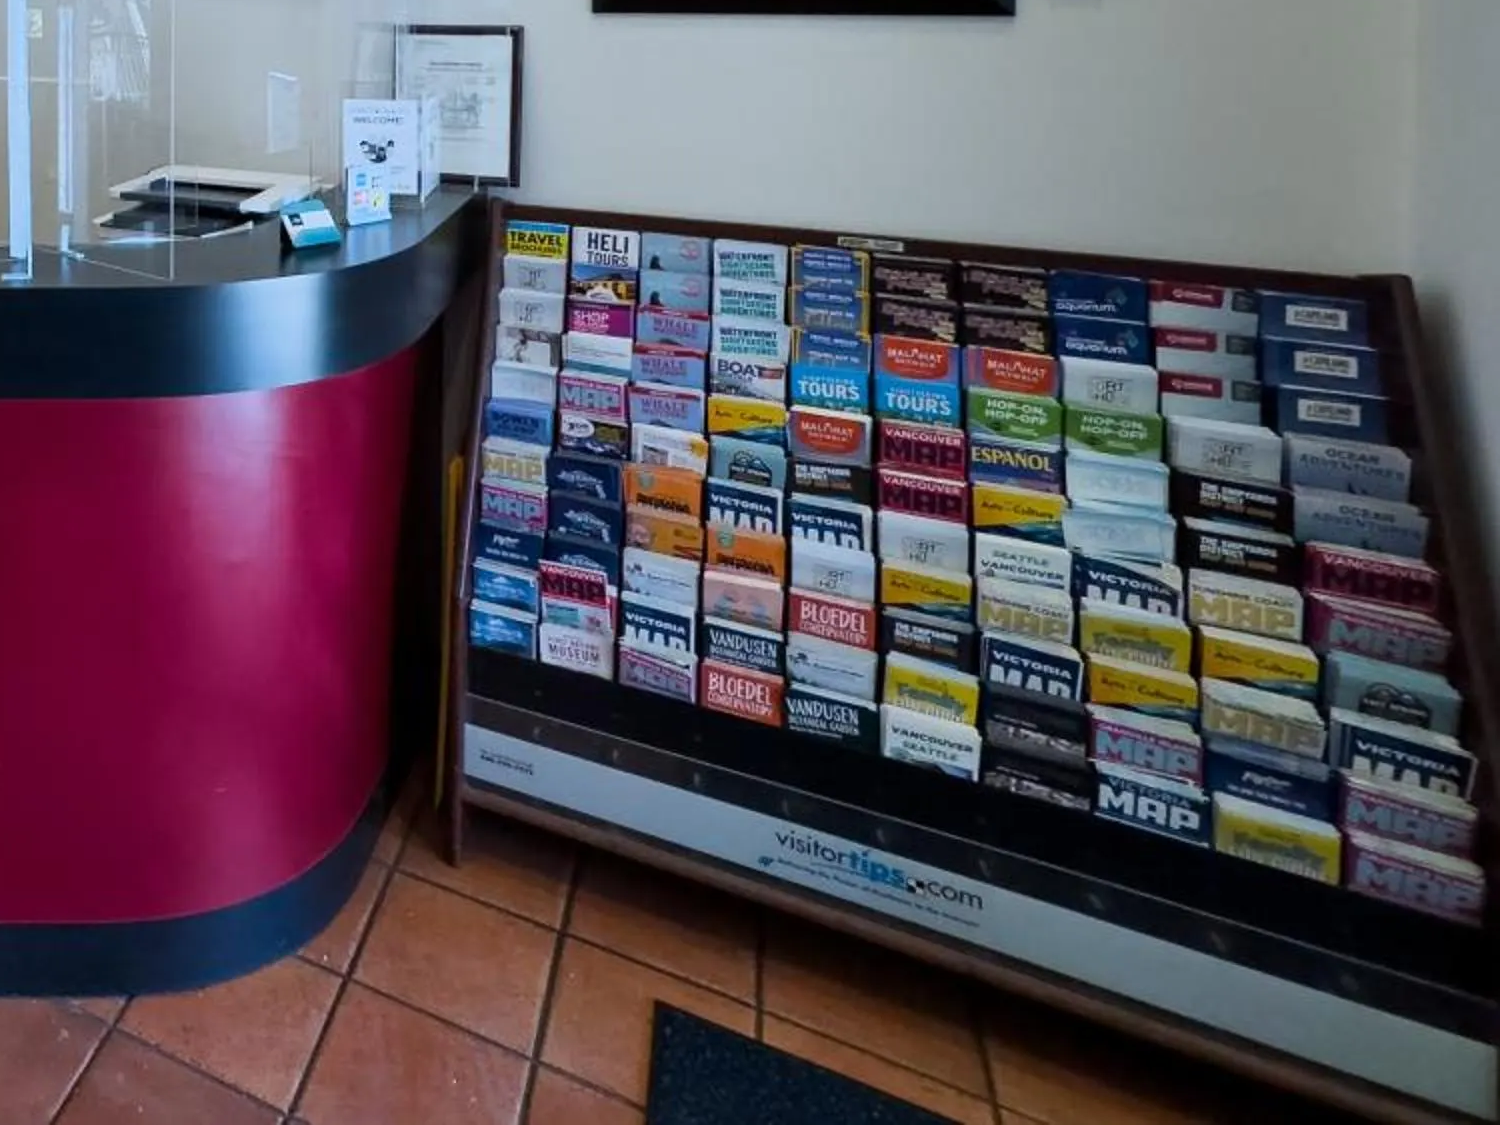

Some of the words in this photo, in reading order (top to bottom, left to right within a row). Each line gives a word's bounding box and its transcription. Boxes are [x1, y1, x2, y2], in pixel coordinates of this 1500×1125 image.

[510, 231, 563, 247] TRAVEL
[587, 232, 629, 253] HELI
[586, 251, 629, 267] TOURS
[717, 359, 760, 378] BOAT
[562, 384, 619, 409] MAP
[798, 380, 860, 400] TOURS
[887, 392, 950, 415] TOURS
[985, 408, 1048, 424] HOP-OFF
[885, 428, 961, 447] VANCOUVER
[1080, 426, 1147, 440] HOP-OFF
[484, 456, 542, 479] MAP
[1325, 449, 1380, 465] OCEAN
[883, 477, 961, 495] VANCOUVER
[484, 495, 537, 519] MAP
[711, 494, 772, 513] VICTORIA
[1013, 505, 1054, 519] Culture
[792, 513, 857, 531] VICTORIA
[981, 559, 1064, 580] VANCOUVER
[992, 550, 1049, 567] SEATTLE
[1323, 554, 1432, 582] VANCOUVER
[1089, 572, 1173, 595] VICTORIA
[801, 600, 868, 634] BLOEDEL
[980, 600, 1069, 641] MAP
[1192, 592, 1295, 629] MAP
[626, 612, 685, 634] VICTORIA
[710, 628, 777, 660] VANDUSEN
[1329, 619, 1449, 664] MAP
[549, 644, 599, 663] MUSEUM
[993, 651, 1072, 679] VICTORIA
[1254, 659, 1305, 678] Culture
[708, 673, 772, 705] BLOEDEL
[1138, 684, 1185, 703] Culture
[787, 698, 859, 725] VANDUSEN
[892, 727, 973, 752] VANCOUVER
[1205, 709, 1322, 754] MAP
[903, 741, 958, 761] SEATTLE
[1096, 730, 1198, 775] MAP
[1356, 739, 1460, 776] VICTORIA
[1109, 777, 1191, 808] VICTORIA
[1099, 783, 1200, 830] MAP
[1347, 796, 1471, 848] MAP
[1355, 858, 1480, 908] MAP
